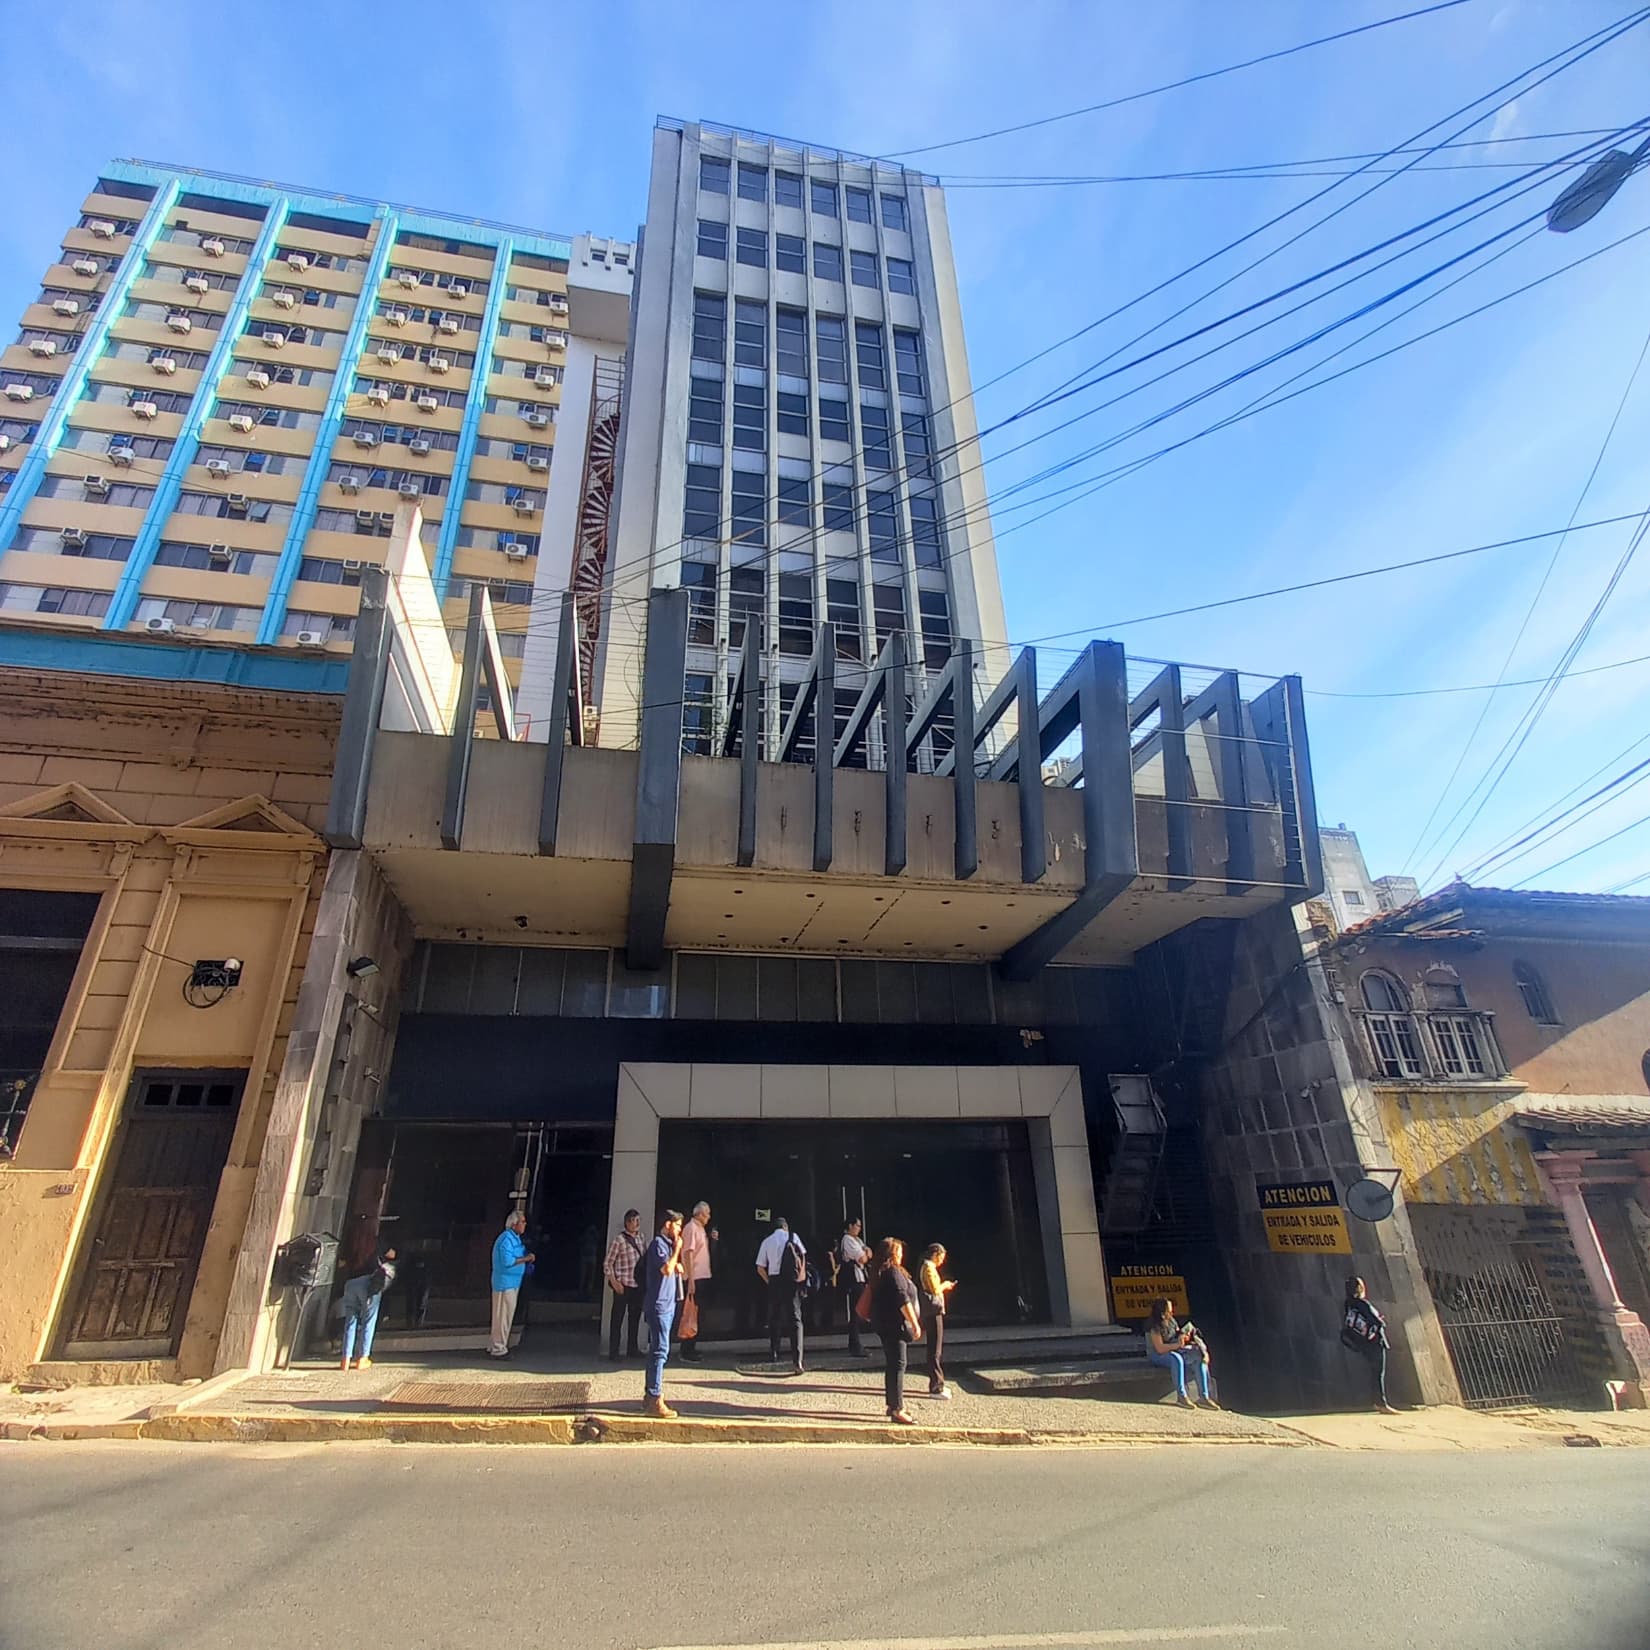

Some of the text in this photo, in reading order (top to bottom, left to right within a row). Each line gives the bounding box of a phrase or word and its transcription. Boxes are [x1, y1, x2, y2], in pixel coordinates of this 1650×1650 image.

[1264, 1186, 1331, 1203] ATENCION
[1266, 1214, 1340, 1227] ENTRADA Y SALIDA
[1278, 1234, 1336, 1246] DE VEHICULOS
[1121, 1265, 1174, 1276] ATENCION
[1116, 1285, 1148, 1294] ENTRADA
[1158, 1283, 1182, 1293] SALIDA
